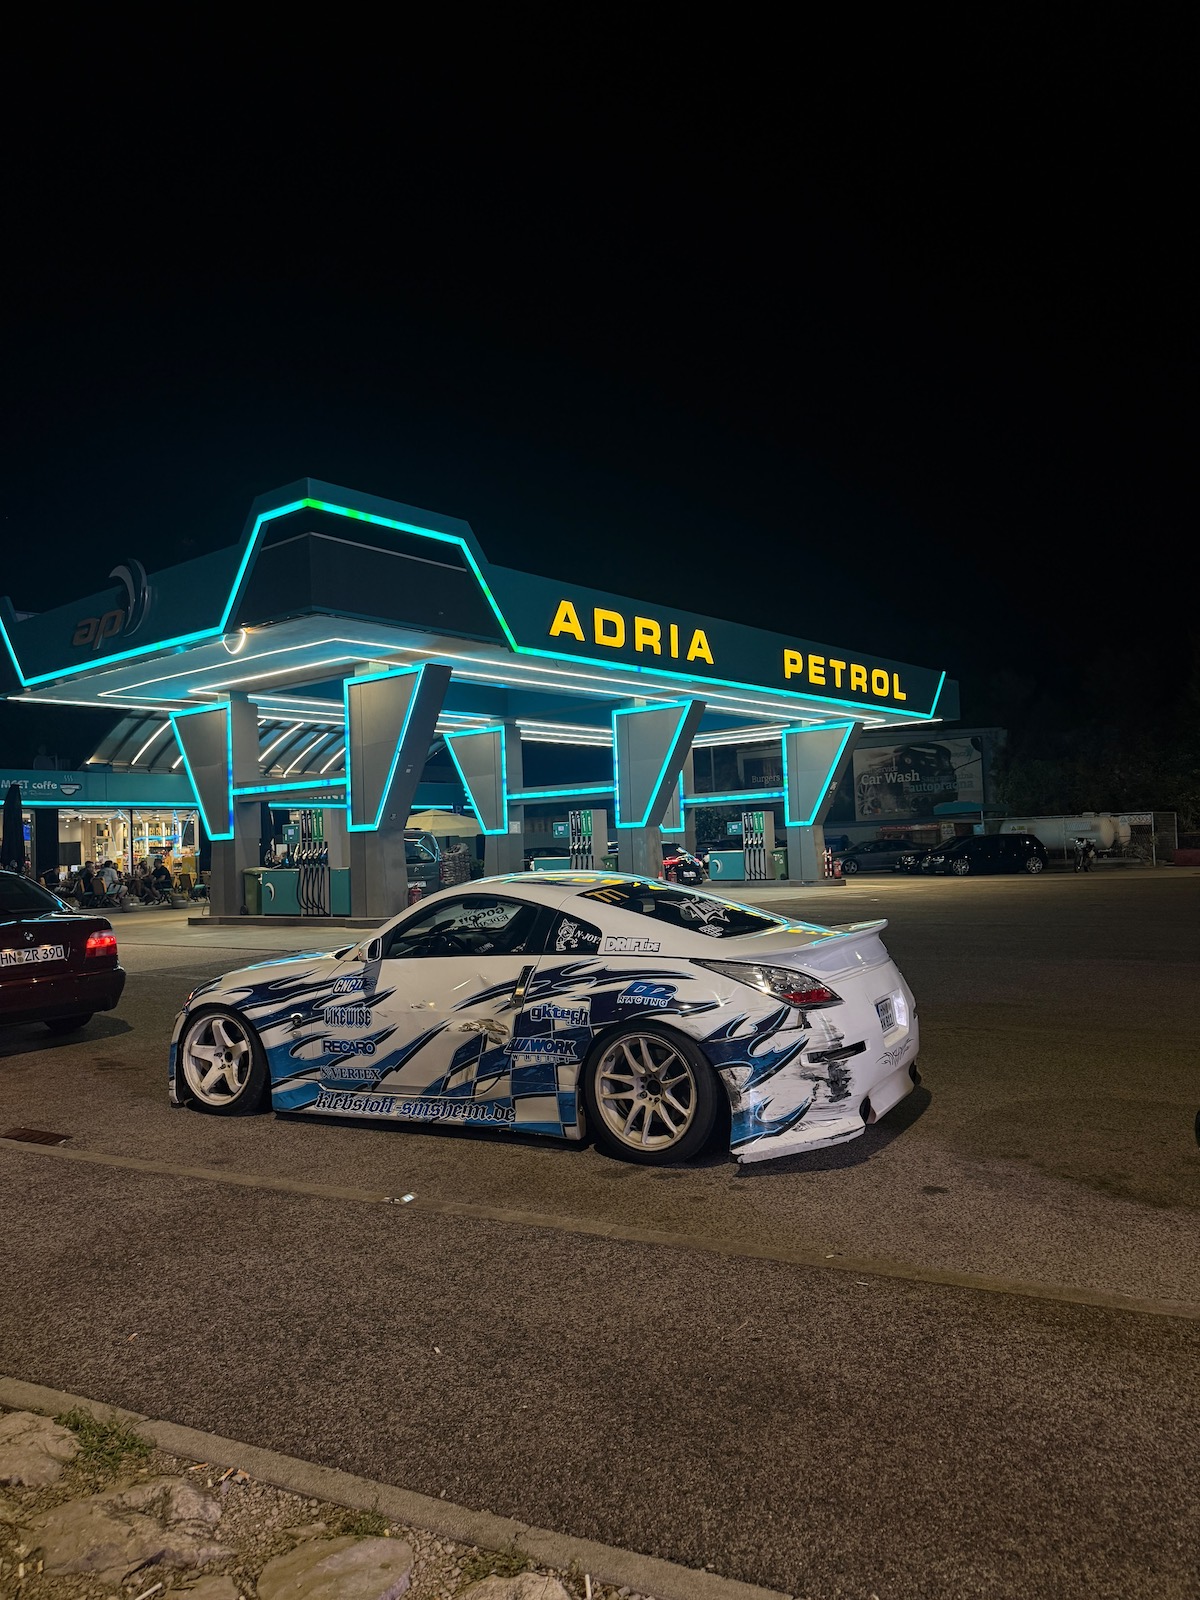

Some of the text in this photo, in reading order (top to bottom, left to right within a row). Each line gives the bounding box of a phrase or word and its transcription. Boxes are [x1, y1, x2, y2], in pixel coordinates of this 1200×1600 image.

[549, 599, 908, 701] ADRIA PETROL
[32, 780, 58, 790] caffe
[751, 773, 782, 785] Burgers
[861, 774, 882, 785] Car
[884, 769, 921, 784] Wash
[0, 946, 64, 965] HN ZR 390
[617, 995, 668, 1008] RACING
[324, 1007, 372, 1028] LIKEWISE
[531, 1004, 588, 1021] gktech
[322, 1039, 377, 1056] RECARO
[531, 1038, 577, 1056] WORK
[330, 1067, 381, 1081] VERTEX
